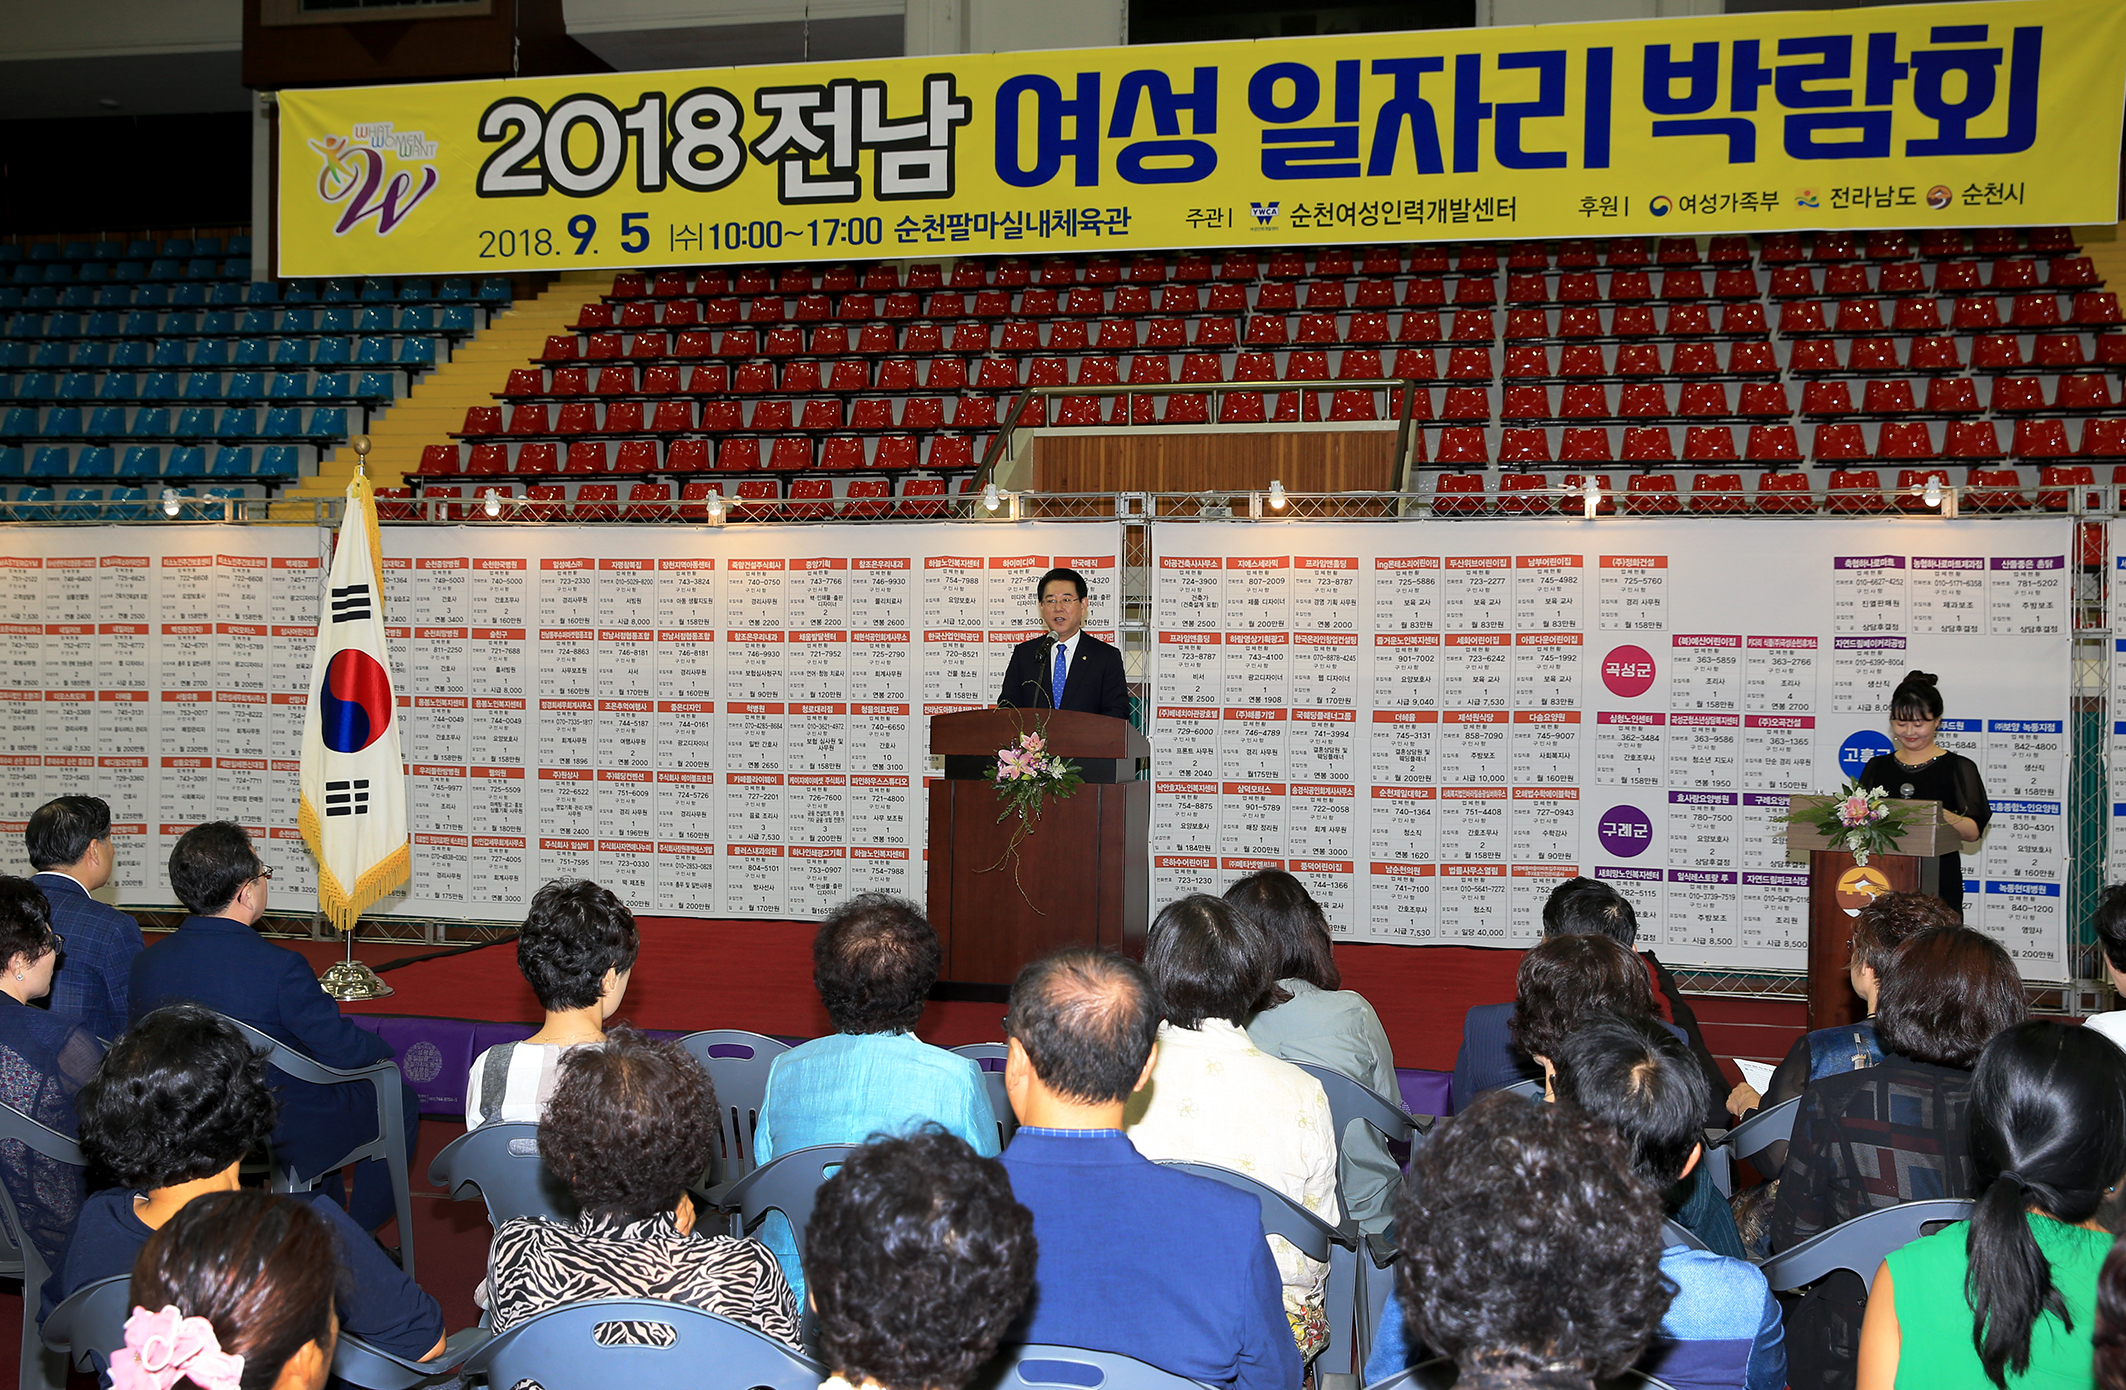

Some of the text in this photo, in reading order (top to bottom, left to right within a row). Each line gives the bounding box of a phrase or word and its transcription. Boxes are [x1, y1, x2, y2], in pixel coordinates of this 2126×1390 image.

[476, 24, 2044, 205] 2018 전남 여성 일자리 박람회
[355, 125, 391, 139] WHAT
[371, 134, 423, 148] WOMEN
[399, 144, 436, 157] WANT
[1678, 191, 1779, 215] 여성가족부
[1830, 186, 1917, 209] 전라남도
[1961, 182, 2025, 206] 순천시
[1290, 196, 1517, 228] 순천여성인력개발센터
[478, 228, 561, 258] 2018.
[620, 212, 650, 254] 5
[894, 206, 1132, 243] 순천팔마실내체육관
[1528, 558, 1571, 566] 남부어린이집
[749, 578, 780, 586] 740-0750
[811, 577, 842, 585] 743-7766
[946, 576, 978, 584] 754-7988
[1182, 577, 1217, 585] 724-3900
[1249, 577, 1285, 585] 807-2009
[1318, 577, 1353, 585] 723-8787
[1399, 577, 1435, 585] 725-5886
[1470, 577, 1505, 585] 723-2277
[1541, 576, 1577, 584] 745-4982
[1624, 577, 1662, 585] 725-5760
[2018, 579, 2058, 587] 781-5202
[958, 618, 981, 626] 12,000
[1198, 620, 1215, 628] 2500
[1410, 620, 1432, 628] 83만원
[873, 650, 905, 658] 725-2790
[946, 649, 978, 657] 720-8521
[1249, 653, 1283, 661] 743-4100
[1398, 654, 1434, 662] 901-7002
[1469, 654, 1505, 662] 723-6242
[1541, 654, 1576, 662] 745-1992
[1697, 656, 1736, 664] 363-5859
[1772, 657, 1811, 665] 363-2766
[1606, 663, 1651, 677] 곡성군
[1178, 727, 1213, 735] 729-6000
[1246, 729, 1280, 737] 746-4789
[1315, 729, 1349, 737] 741-3994
[1397, 731, 1430, 739] 745-3131
[1465, 731, 1503, 739] 858-7090
[1537, 732, 1574, 740] 745-9007
[2015, 742, 2057, 750] 842-4800
[1479, 774, 1505, 782] 10,000
[618, 789, 649, 797] 751-6009
[678, 791, 709, 799] 724-5726
[748, 792, 778, 800] 727-2201
[872, 794, 904, 802] 721-4800
[1178, 802, 1213, 810] 754-8875
[1246, 803, 1280, 811] 901-5789
[1313, 805, 1349, 813] 722-0058
[1396, 807, 1430, 815] 740-1364
[1537, 808, 1574, 816] 727-0943
[1693, 813, 1732, 821] 780-7500
[1602, 822, 1649, 839] 구례군
[2013, 823, 2054, 831] 830-4301
[888, 836, 903, 844] 1900
[1329, 848, 1347, 856] 3000
[809, 866, 841, 874] 753-0907
[1178, 876, 1212, 884] 723-1230
[1395, 884, 1429, 892] 741-7100
[1620, 889, 1657, 898] 782-5115
[2012, 904, 2053, 913] 840-1200
[1477, 928, 1504, 936] 40,000
[1709, 937, 1732, 945] 8,500
[2023, 951, 2053, 959] 200만원
